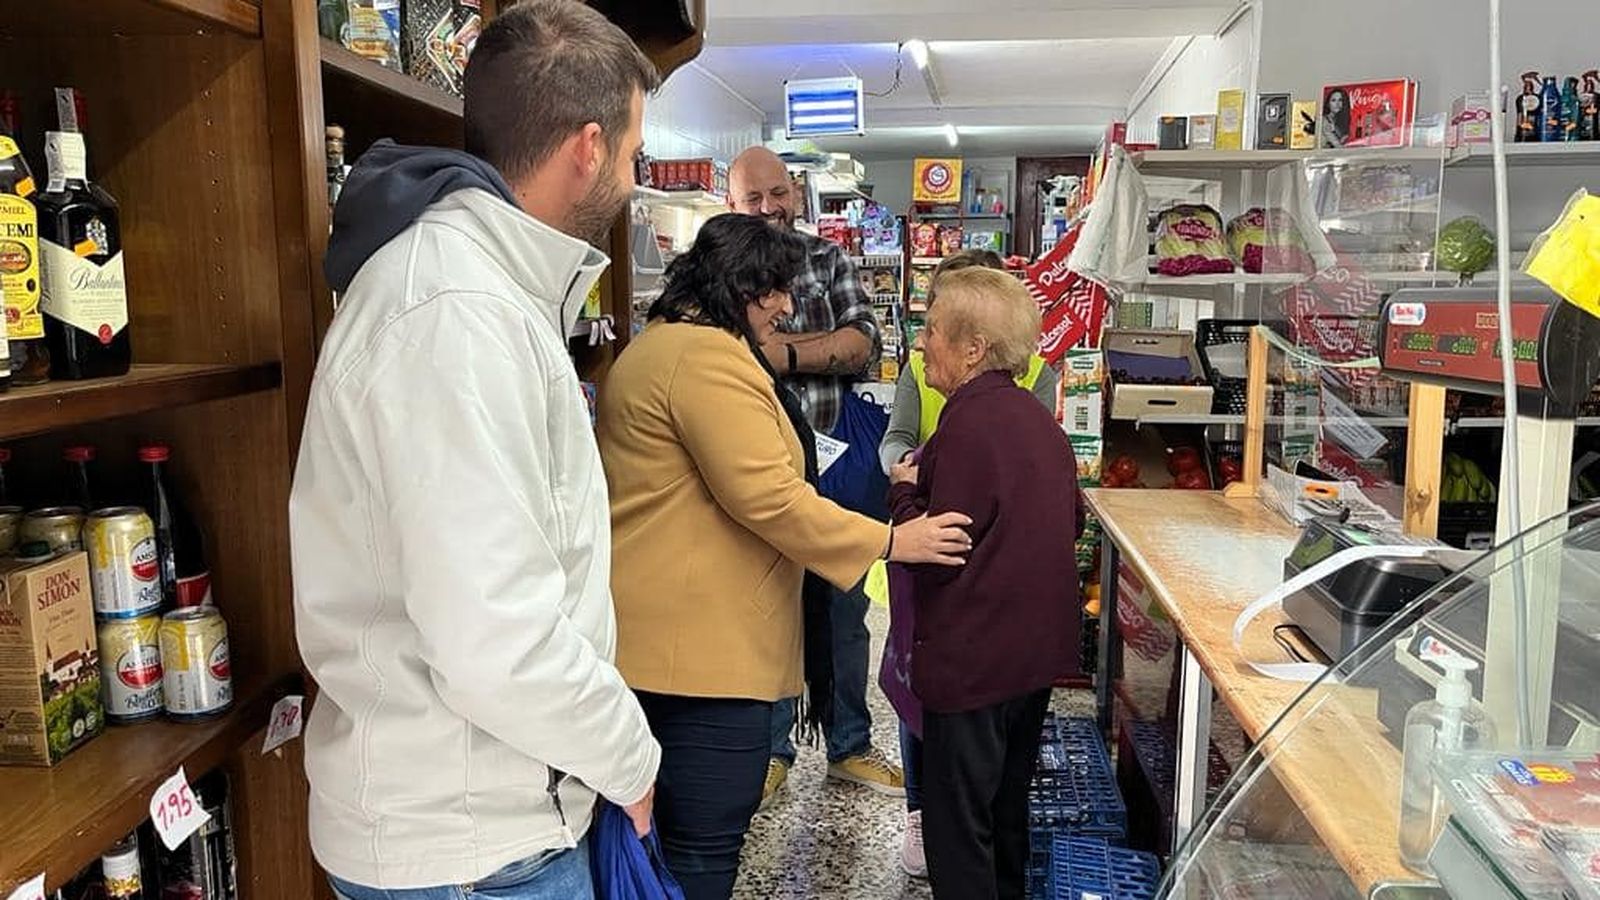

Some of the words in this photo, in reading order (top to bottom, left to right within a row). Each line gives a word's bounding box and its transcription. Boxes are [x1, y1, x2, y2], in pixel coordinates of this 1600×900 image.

[0, 223, 34, 238] EMI
[45, 569, 71, 589] DON
[37, 578, 80, 611] SIMON
[157, 784, 192, 831] 1,95
